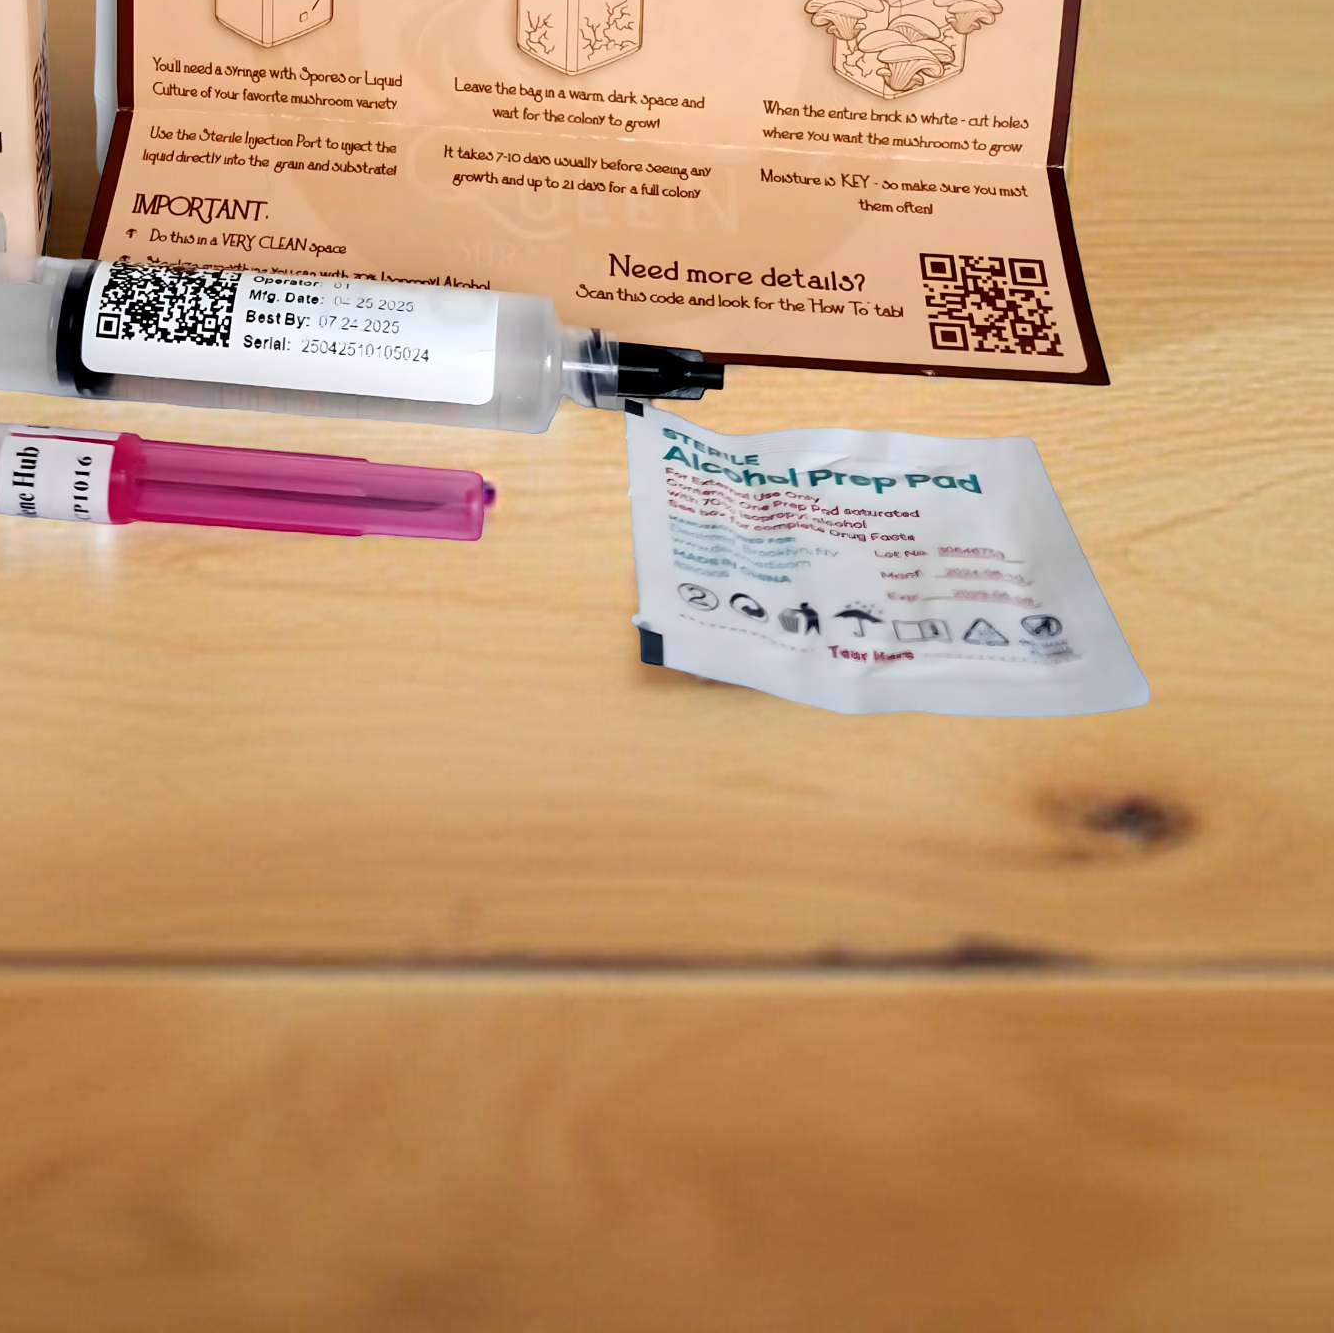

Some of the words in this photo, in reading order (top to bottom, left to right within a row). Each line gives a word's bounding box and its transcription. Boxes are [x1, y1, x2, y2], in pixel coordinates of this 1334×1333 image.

[184, 62, 212, 74] need
[215, 66, 222, 75] a
[225, 66, 266, 83] syringe
[269, 67, 296, 80] with
[300, 67, 346, 86] Spores
[348, 76, 362, 84] or
[365, 71, 402, 90] Liquid
[153, 82, 197, 97] Culture
[201, 86, 212, 98] of
[214, 89, 239, 100] your
[243, 89, 288, 103] favorite
[291, 93, 353, 107] mushroom
[455, 77, 492, 93] Leave
[495, 82, 516, 95] the
[520, 84, 543, 103] bag
[545, 89, 555, 98] in
[558, 90, 566, 99] a
[569, 90, 604, 102] warm
[608, 90, 637, 104] dark
[641, 95, 678, 110] space
[681, 97, 704, 108] and
[492, 107, 519, 119] wait
[523, 108, 540, 120] for
[543, 109, 565, 122] the
[568, 112, 605, 125] colony
[608, 114, 622, 126] to
[763, 100, 799, 116] When
[802, 105, 825, 117] the
[828, 107, 867, 120] entire
[871, 109, 902, 122] brick
[906, 114, 917, 123] is
[921, 112, 958, 125] white
[969, 115, 989, 127] cut
[993, 116, 1029, 129] holes
[151, 126, 173, 139] Use
[177, 129, 196, 140] the
[199, 129, 242, 143] Sterile
[245, 131, 293, 149] Injection
[296, 134, 321, 148] Port
[326, 138, 338, 149] to
[341, 141, 372, 155] inject
[375, 141, 396, 153] the
[762, 127, 803, 140] where
[807, 131, 829, 141] you
[833, 132, 863, 143] want
[866, 133, 889, 145] the
[893, 136, 969, 150] mushrooms
[972, 139, 987, 150] to
[142, 149, 174, 165] liquid
[176, 151, 221, 163] directly
[224, 154, 245, 165] into
[248, 155, 269, 167] the
[274, 161, 304, 173] grain
[307, 160, 330, 171] and
[761, 168, 821, 185] Moisture
[825, 177, 836, 186] is
[841, 174, 870, 188] KEY
[882, 180, 898, 190] so
[901, 180, 937, 192] make
[940, 183, 970, 193] sure
[974, 185, 996, 195] you
[999, 185, 1028, 197] mist
[858, 199, 893, 212] them
[149, 228, 167, 242] Do
[170, 231, 195, 244] this
[197, 237, 207, 245] in
[210, 237, 217, 245] a
[223, 233, 256, 251] VERY
[259, 236, 307, 251] CLEAN
[309, 243, 346, 257] space
[609, 254, 678, 280] Need
[687, 269, 753, 285] more
[761, 267, 865, 291] details?
[249, 289, 280, 304] Mfg.
[284, 292, 324, 305] Date:
[576, 284, 614, 300] Scan
[617, 288, 647, 302] this
[650, 292, 684, 304] code
[689, 295, 714, 306] and
[718, 295, 750, 308] look
[754, 297, 775, 309] for
[778, 298, 805, 311] the
[245, 309, 281, 326] Best
[284, 311, 311, 329] By:
[243, 334, 291, 352] Serial:
[662, 427, 760, 467] STERILE
[12, 446, 40, 488] Hub
[662, 445, 799, 488] Alcohol
[808, 468, 897, 494] Prep
[904, 474, 982, 495] Pad
